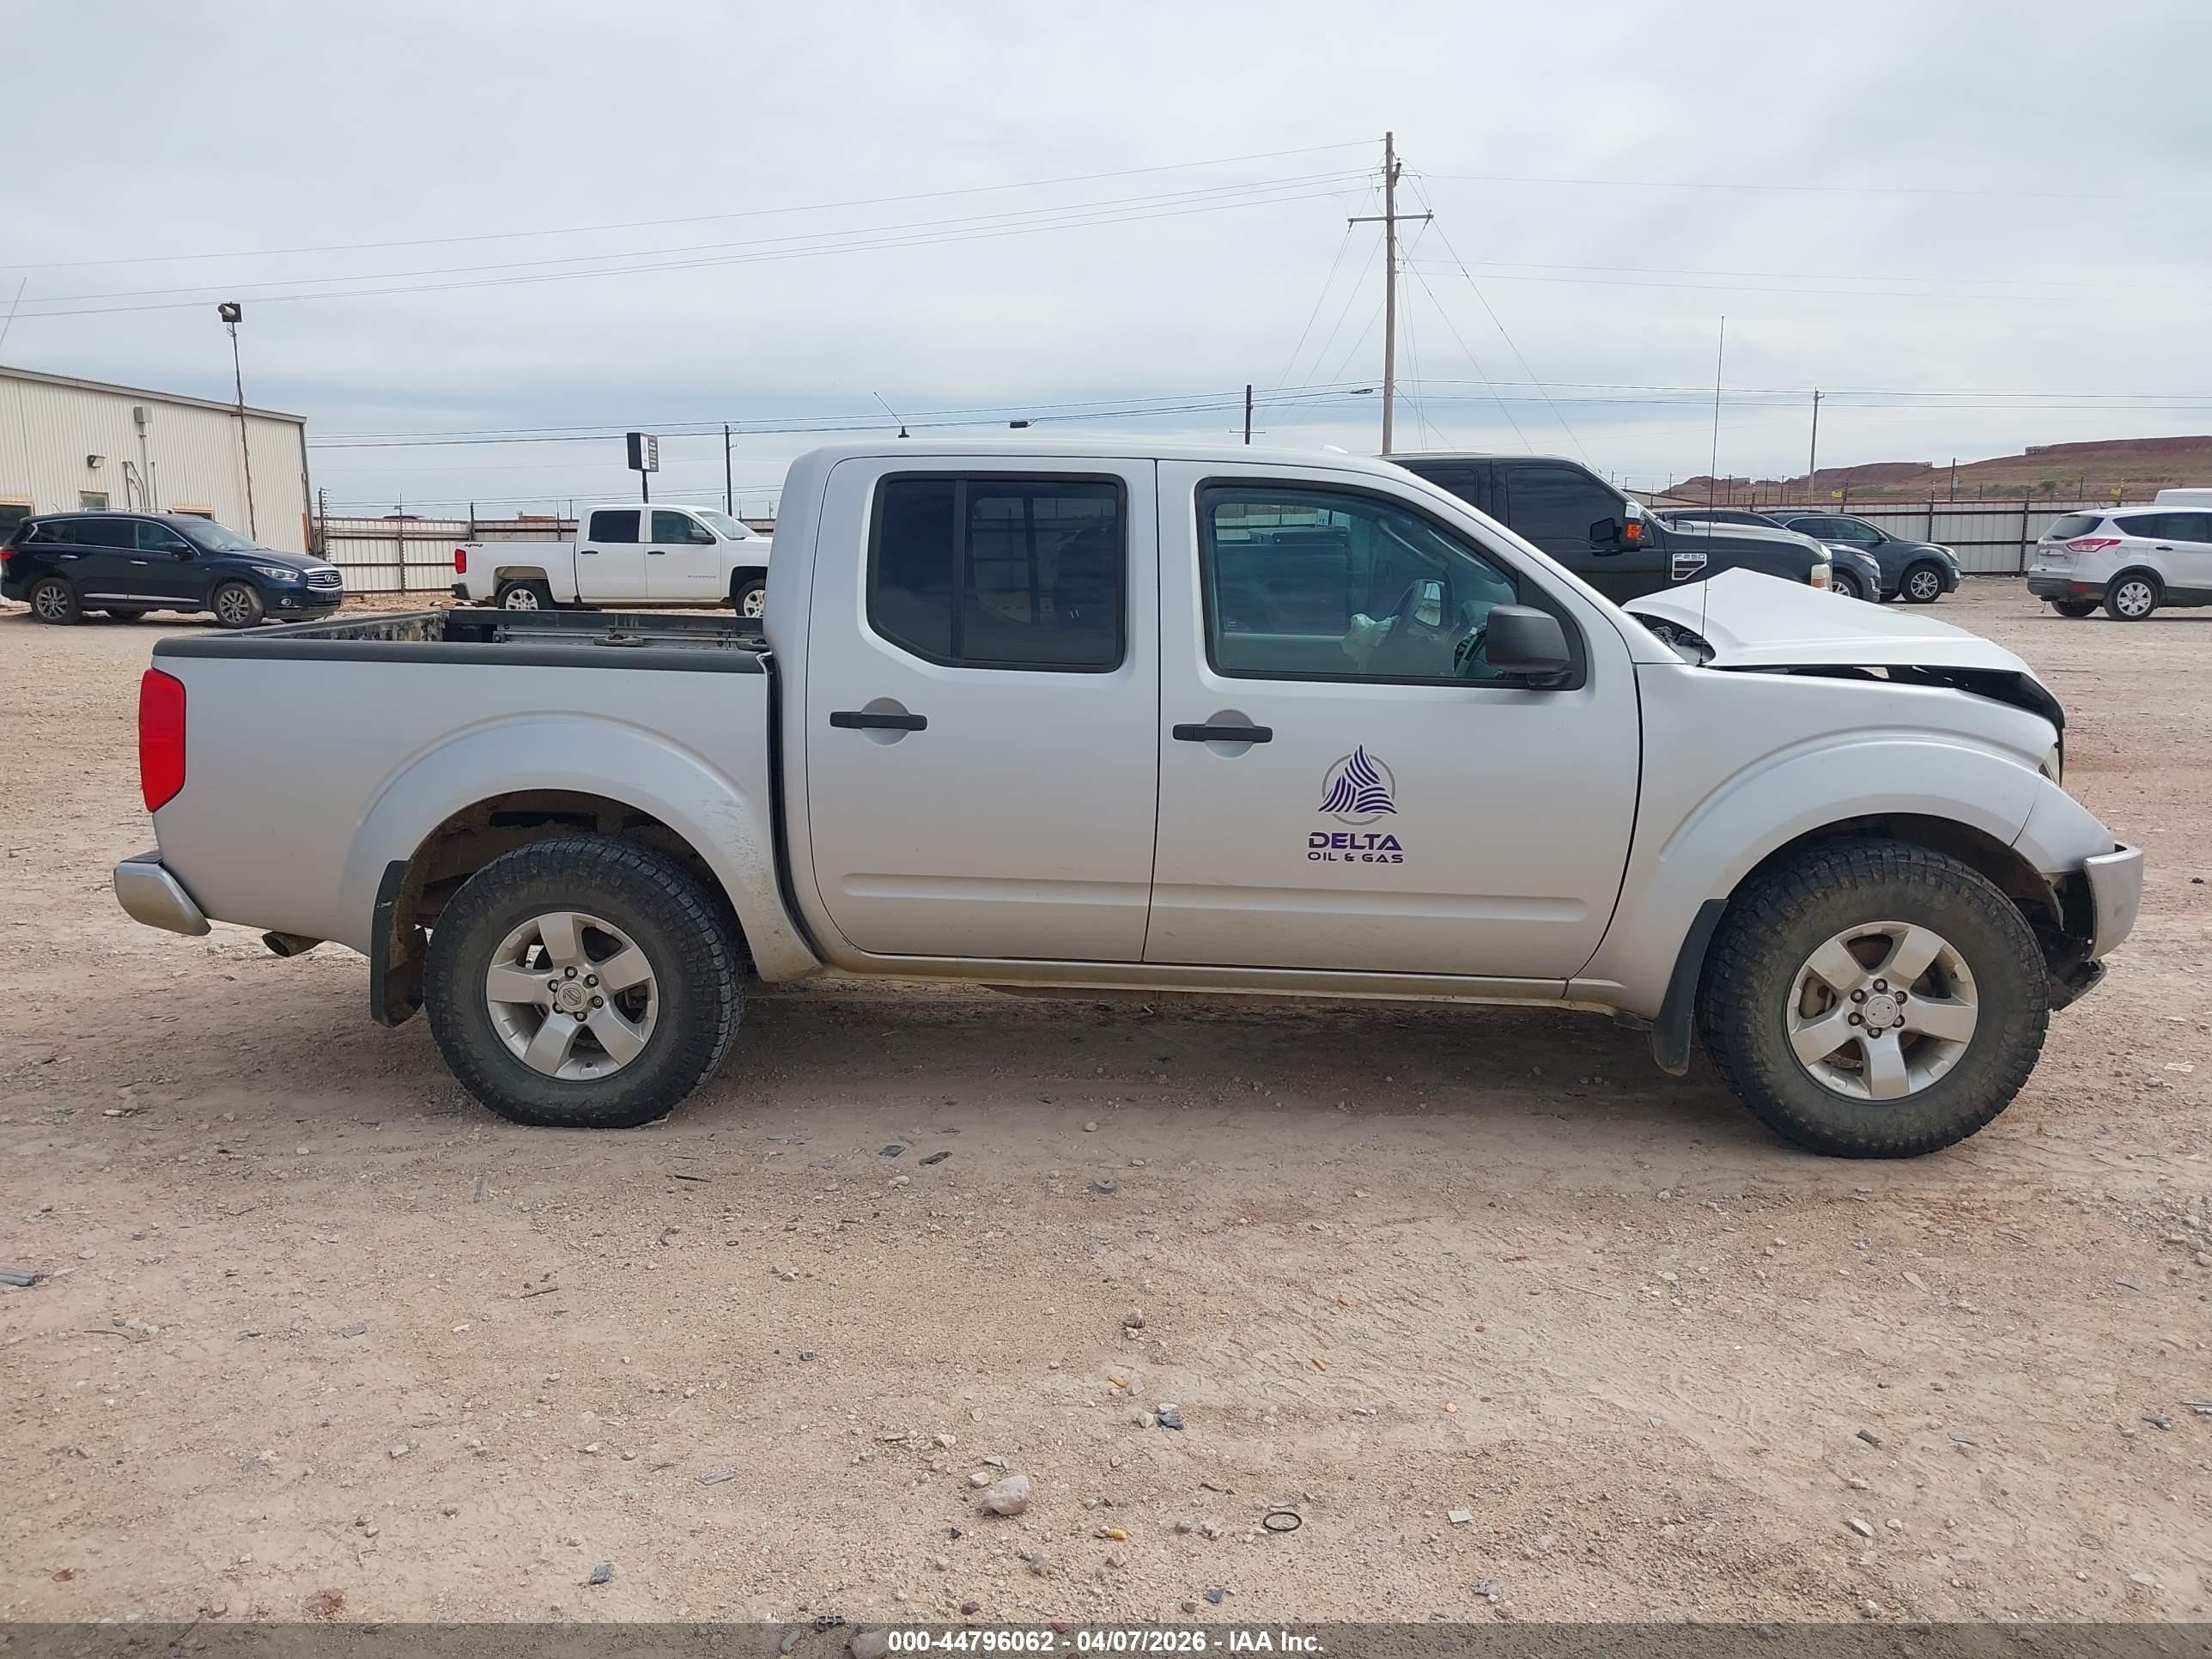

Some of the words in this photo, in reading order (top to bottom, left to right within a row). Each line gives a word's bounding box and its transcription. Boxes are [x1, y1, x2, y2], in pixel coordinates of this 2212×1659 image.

[1309, 832, 1403, 851] DELTA
[1307, 851, 1338, 861] OIL
[1344, 853, 1355, 862] &
[1362, 854, 1404, 864] GAS
